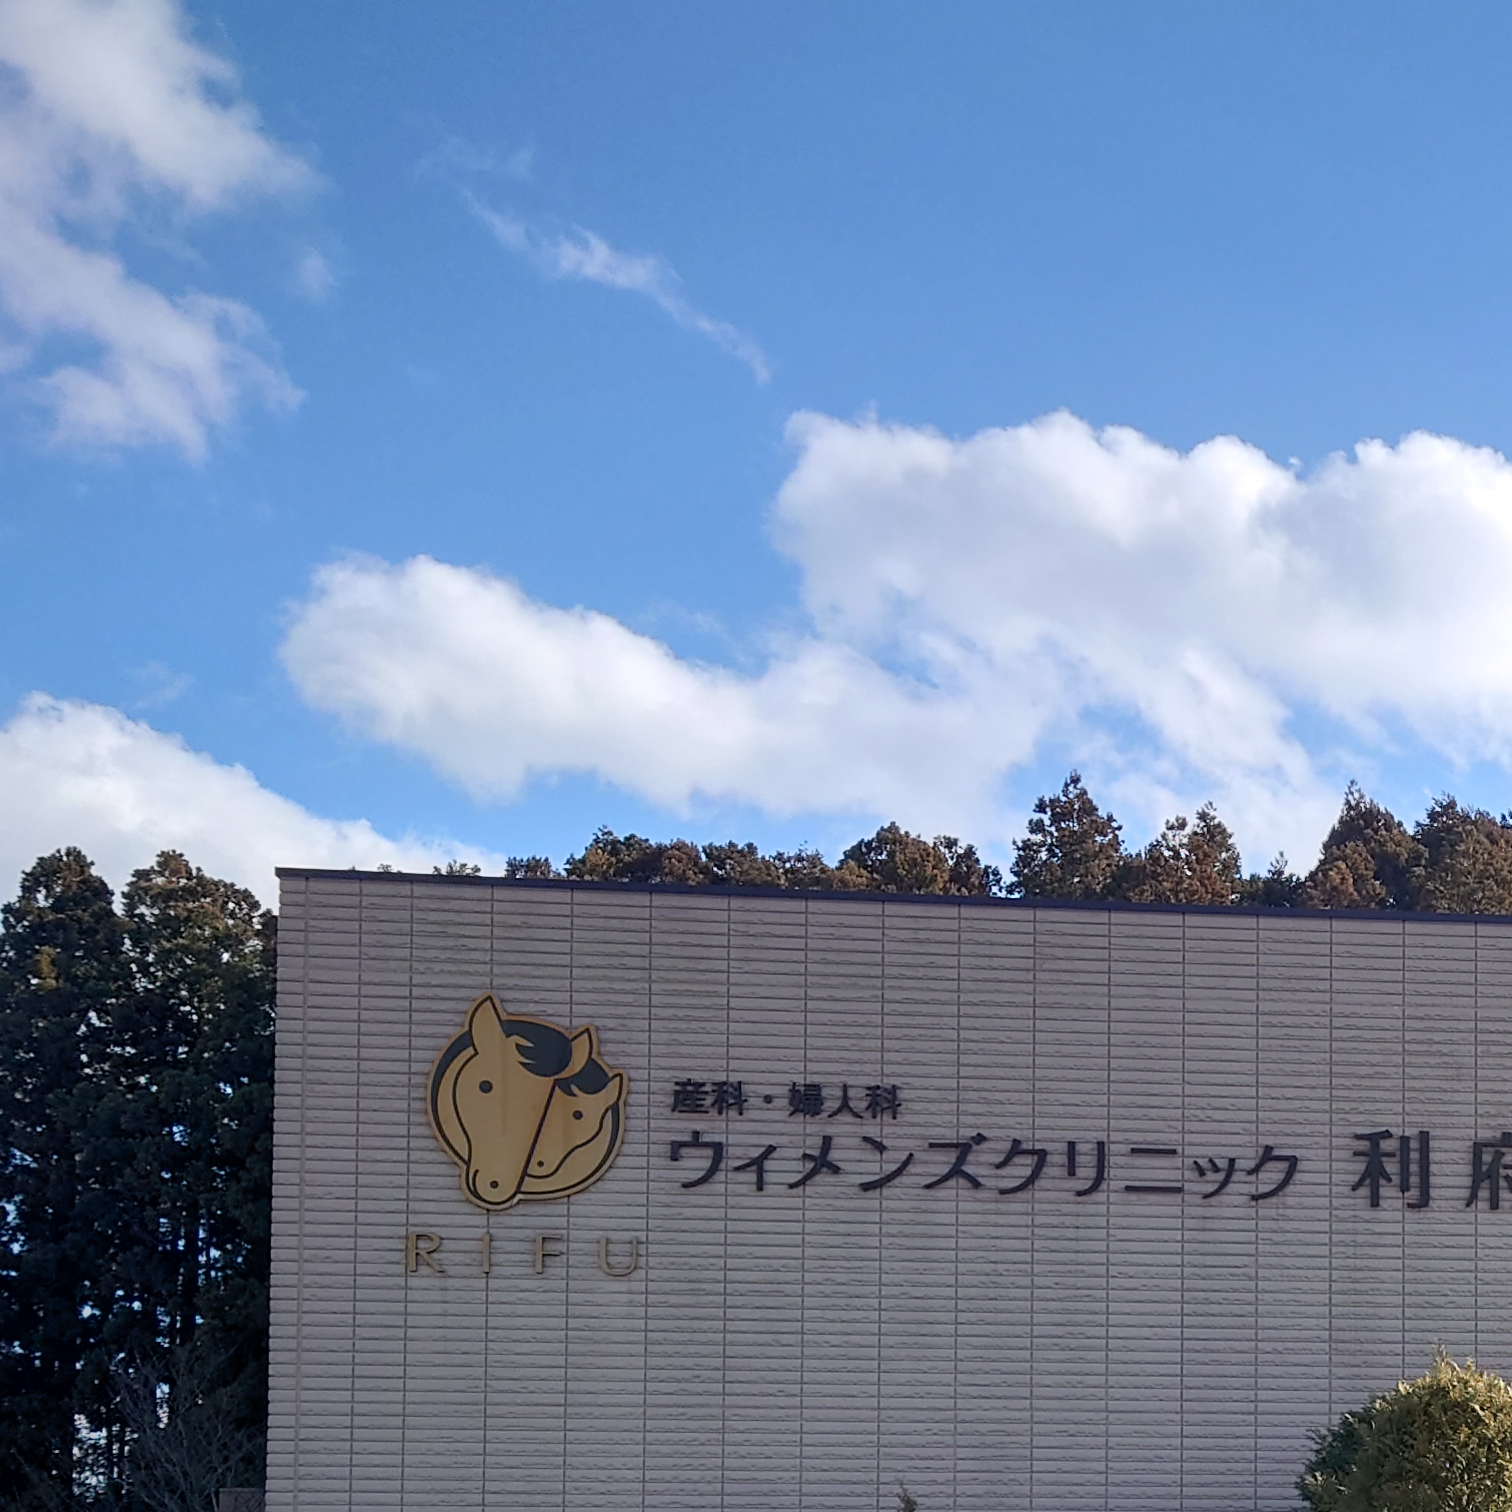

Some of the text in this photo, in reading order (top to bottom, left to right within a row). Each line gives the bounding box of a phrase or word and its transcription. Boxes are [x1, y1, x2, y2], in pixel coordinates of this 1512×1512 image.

[671, 1078, 901, 1119] 産科・婦人科
[669, 1131, 1299, 1200] ウィメンズクリニック
[406, 1232, 639, 1276] RIFU
